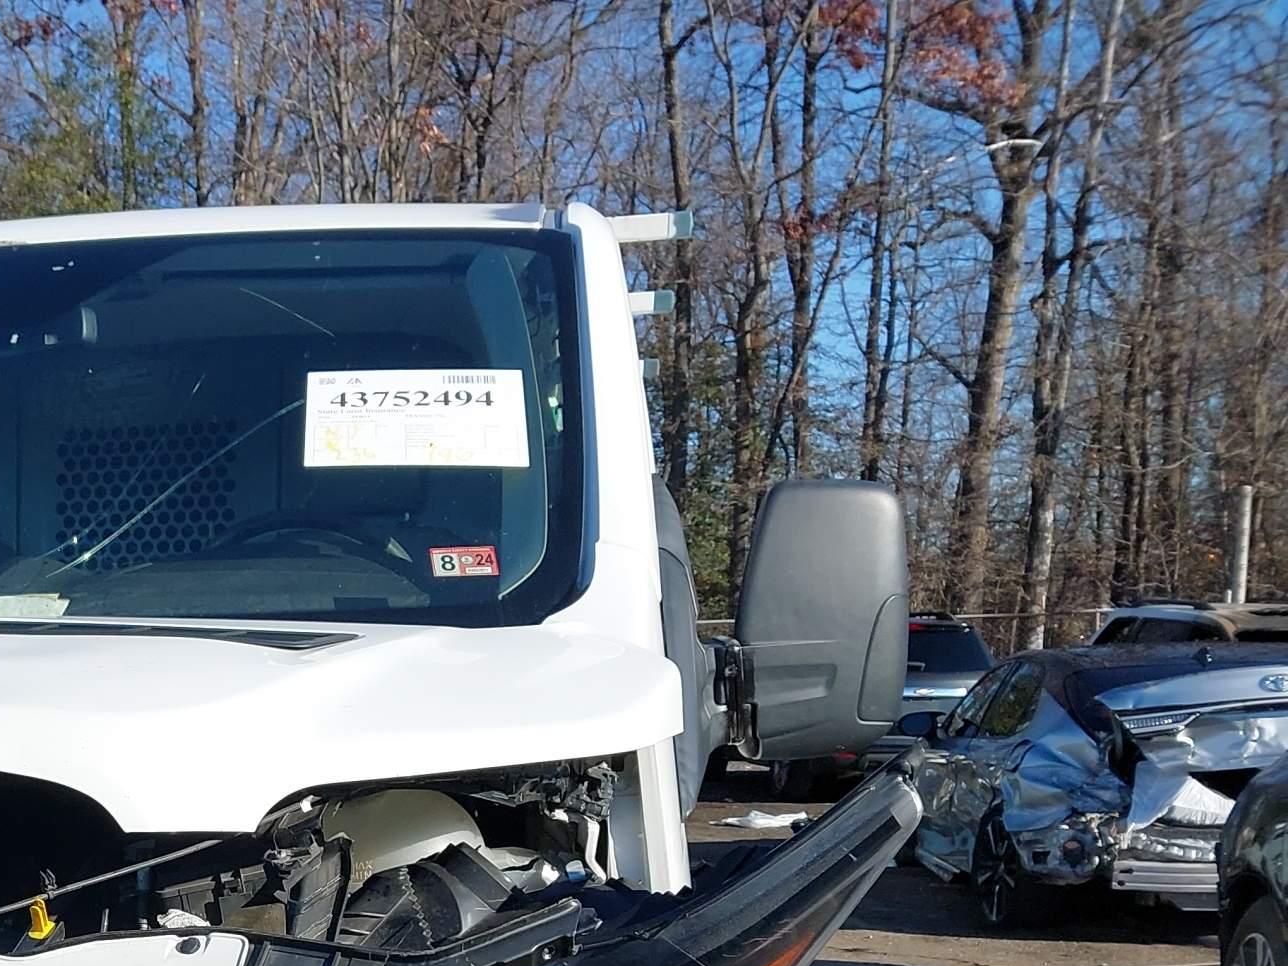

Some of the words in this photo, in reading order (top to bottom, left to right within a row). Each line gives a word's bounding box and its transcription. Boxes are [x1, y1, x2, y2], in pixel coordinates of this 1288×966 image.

[329, 389, 495, 408] 43752494
[440, 554, 456, 572] 8
[475, 553, 495, 566] 24
